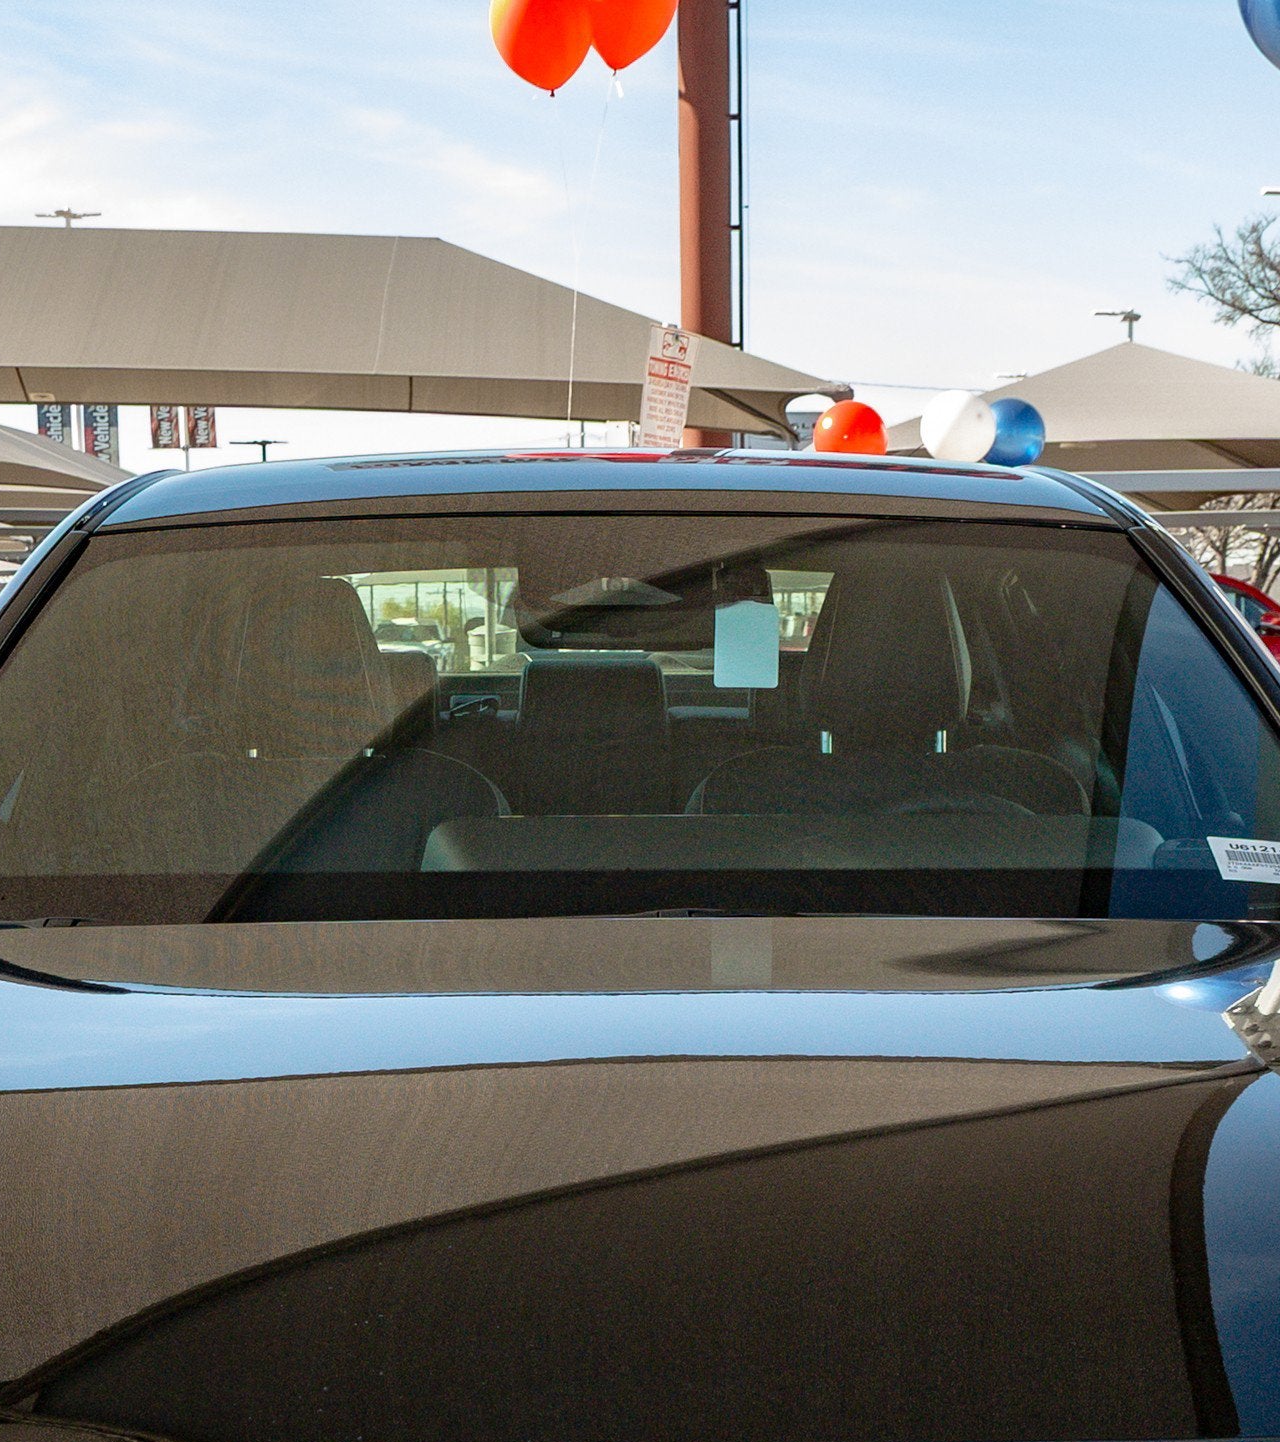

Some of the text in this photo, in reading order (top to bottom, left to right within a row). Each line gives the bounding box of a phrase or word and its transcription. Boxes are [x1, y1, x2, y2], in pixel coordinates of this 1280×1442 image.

[46, 405, 63, 444] ehicle
[92, 405, 110, 452] Vehicle
[159, 421, 173, 445] New
[195, 421, 209, 446] New
